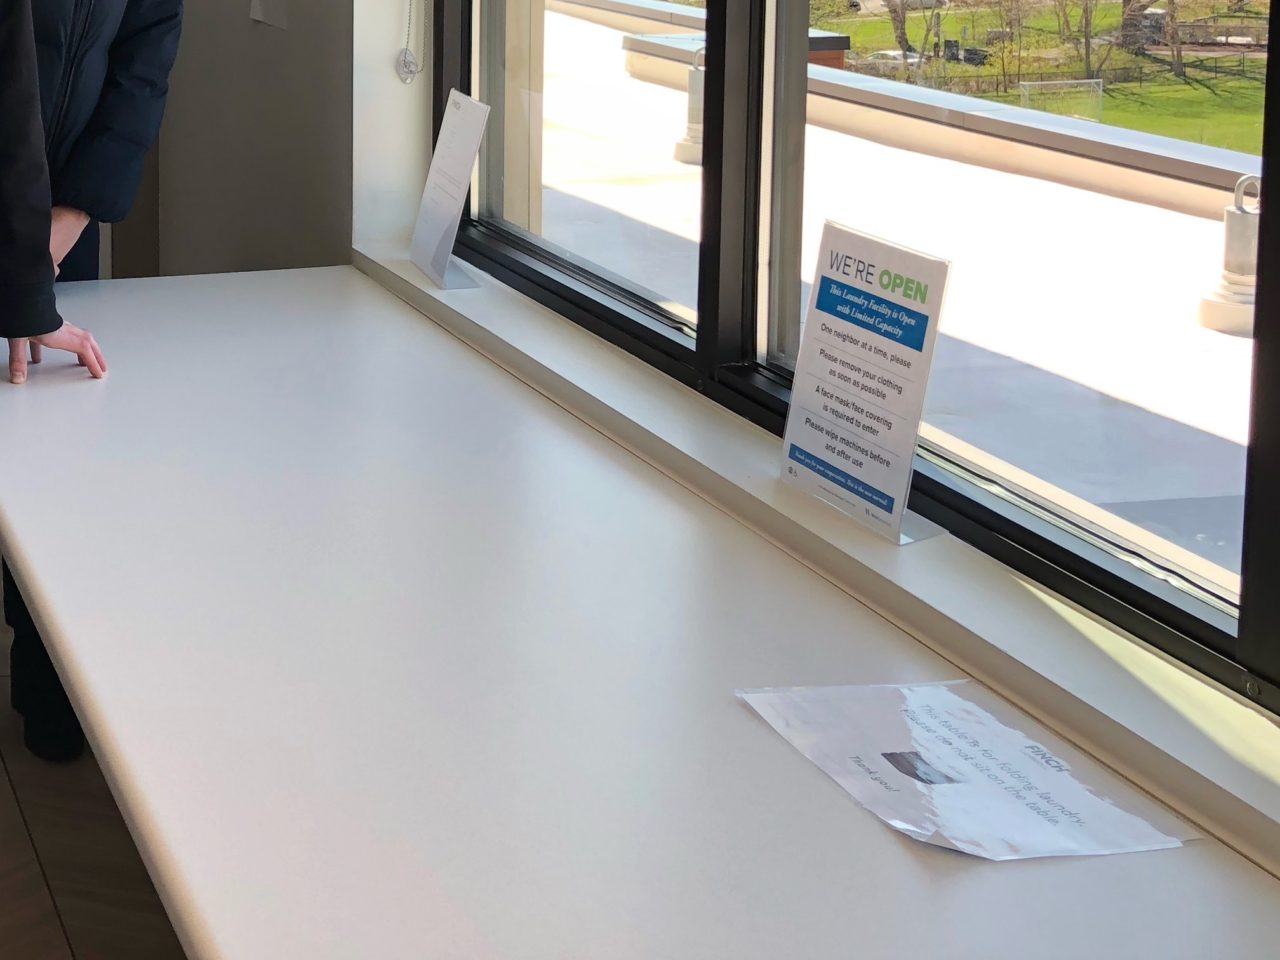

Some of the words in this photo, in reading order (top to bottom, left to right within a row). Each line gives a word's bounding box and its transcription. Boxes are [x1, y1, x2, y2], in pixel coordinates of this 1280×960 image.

[830, 250, 876, 285] WE'RE
[878, 269, 928, 304] OPEN
[830, 284, 842, 297] This
[843, 289, 868, 309] Laundry
[869, 300, 892, 318] Facility
[892, 309, 898, 319] is
[899, 311, 916, 326] Open
[836, 304, 850, 315] with
[851, 308, 875, 325] Limited
[875, 318, 903, 338] Capacity
[821, 323, 832, 334] One
[833, 330, 860, 347] neighbor
[861, 341, 868, 350] at
[874, 346, 889, 360] time,
[890, 354, 912, 369] please
[819, 348, 838, 363] Please
[839, 359, 862, 374] remove
[862, 370, 877, 381] your
[877, 376, 903, 395] clothing
[829, 369, 836, 377] as
[837, 372, 852, 384] soon
[852, 379, 860, 388] as
[860, 382, 887, 400] possible
[815, 385, 820, 393] A
[821, 387, 834, 400] face
[835, 395, 865, 415] mask/face
[865, 410, 893, 430] covering
[823, 402, 829, 412] is
[829, 406, 854, 424] required
[855, 419, 861, 428] to
[862, 424, 879, 436] enter
[805, 417, 825, 433] Please
[825, 429, 839, 442] wipe
[839, 436, 869, 456] machines
[870, 450, 891, 468] before
[825, 443, 836, 454] and
[836, 448, 852, 462] after
[852, 458, 864, 468] use
[848, 755, 879, 775] Thank
[870, 776, 901, 792] you!
[900, 709, 937, 733] Please
[936, 735, 952, 746] do
[951, 747, 976, 761] not
[970, 762, 991, 772] sit
[987, 773, 1005, 785] on
[1004, 786, 1026, 801] the
[1025, 802, 1060, 826] table.
[919, 704, 937, 720] This
[938, 720, 968, 739] table
[980, 749, 999, 761] for
[996, 762, 1038, 792] folding
[1037, 791, 1086, 827] laundry.
[1024, 745, 1071, 772] FINCH
